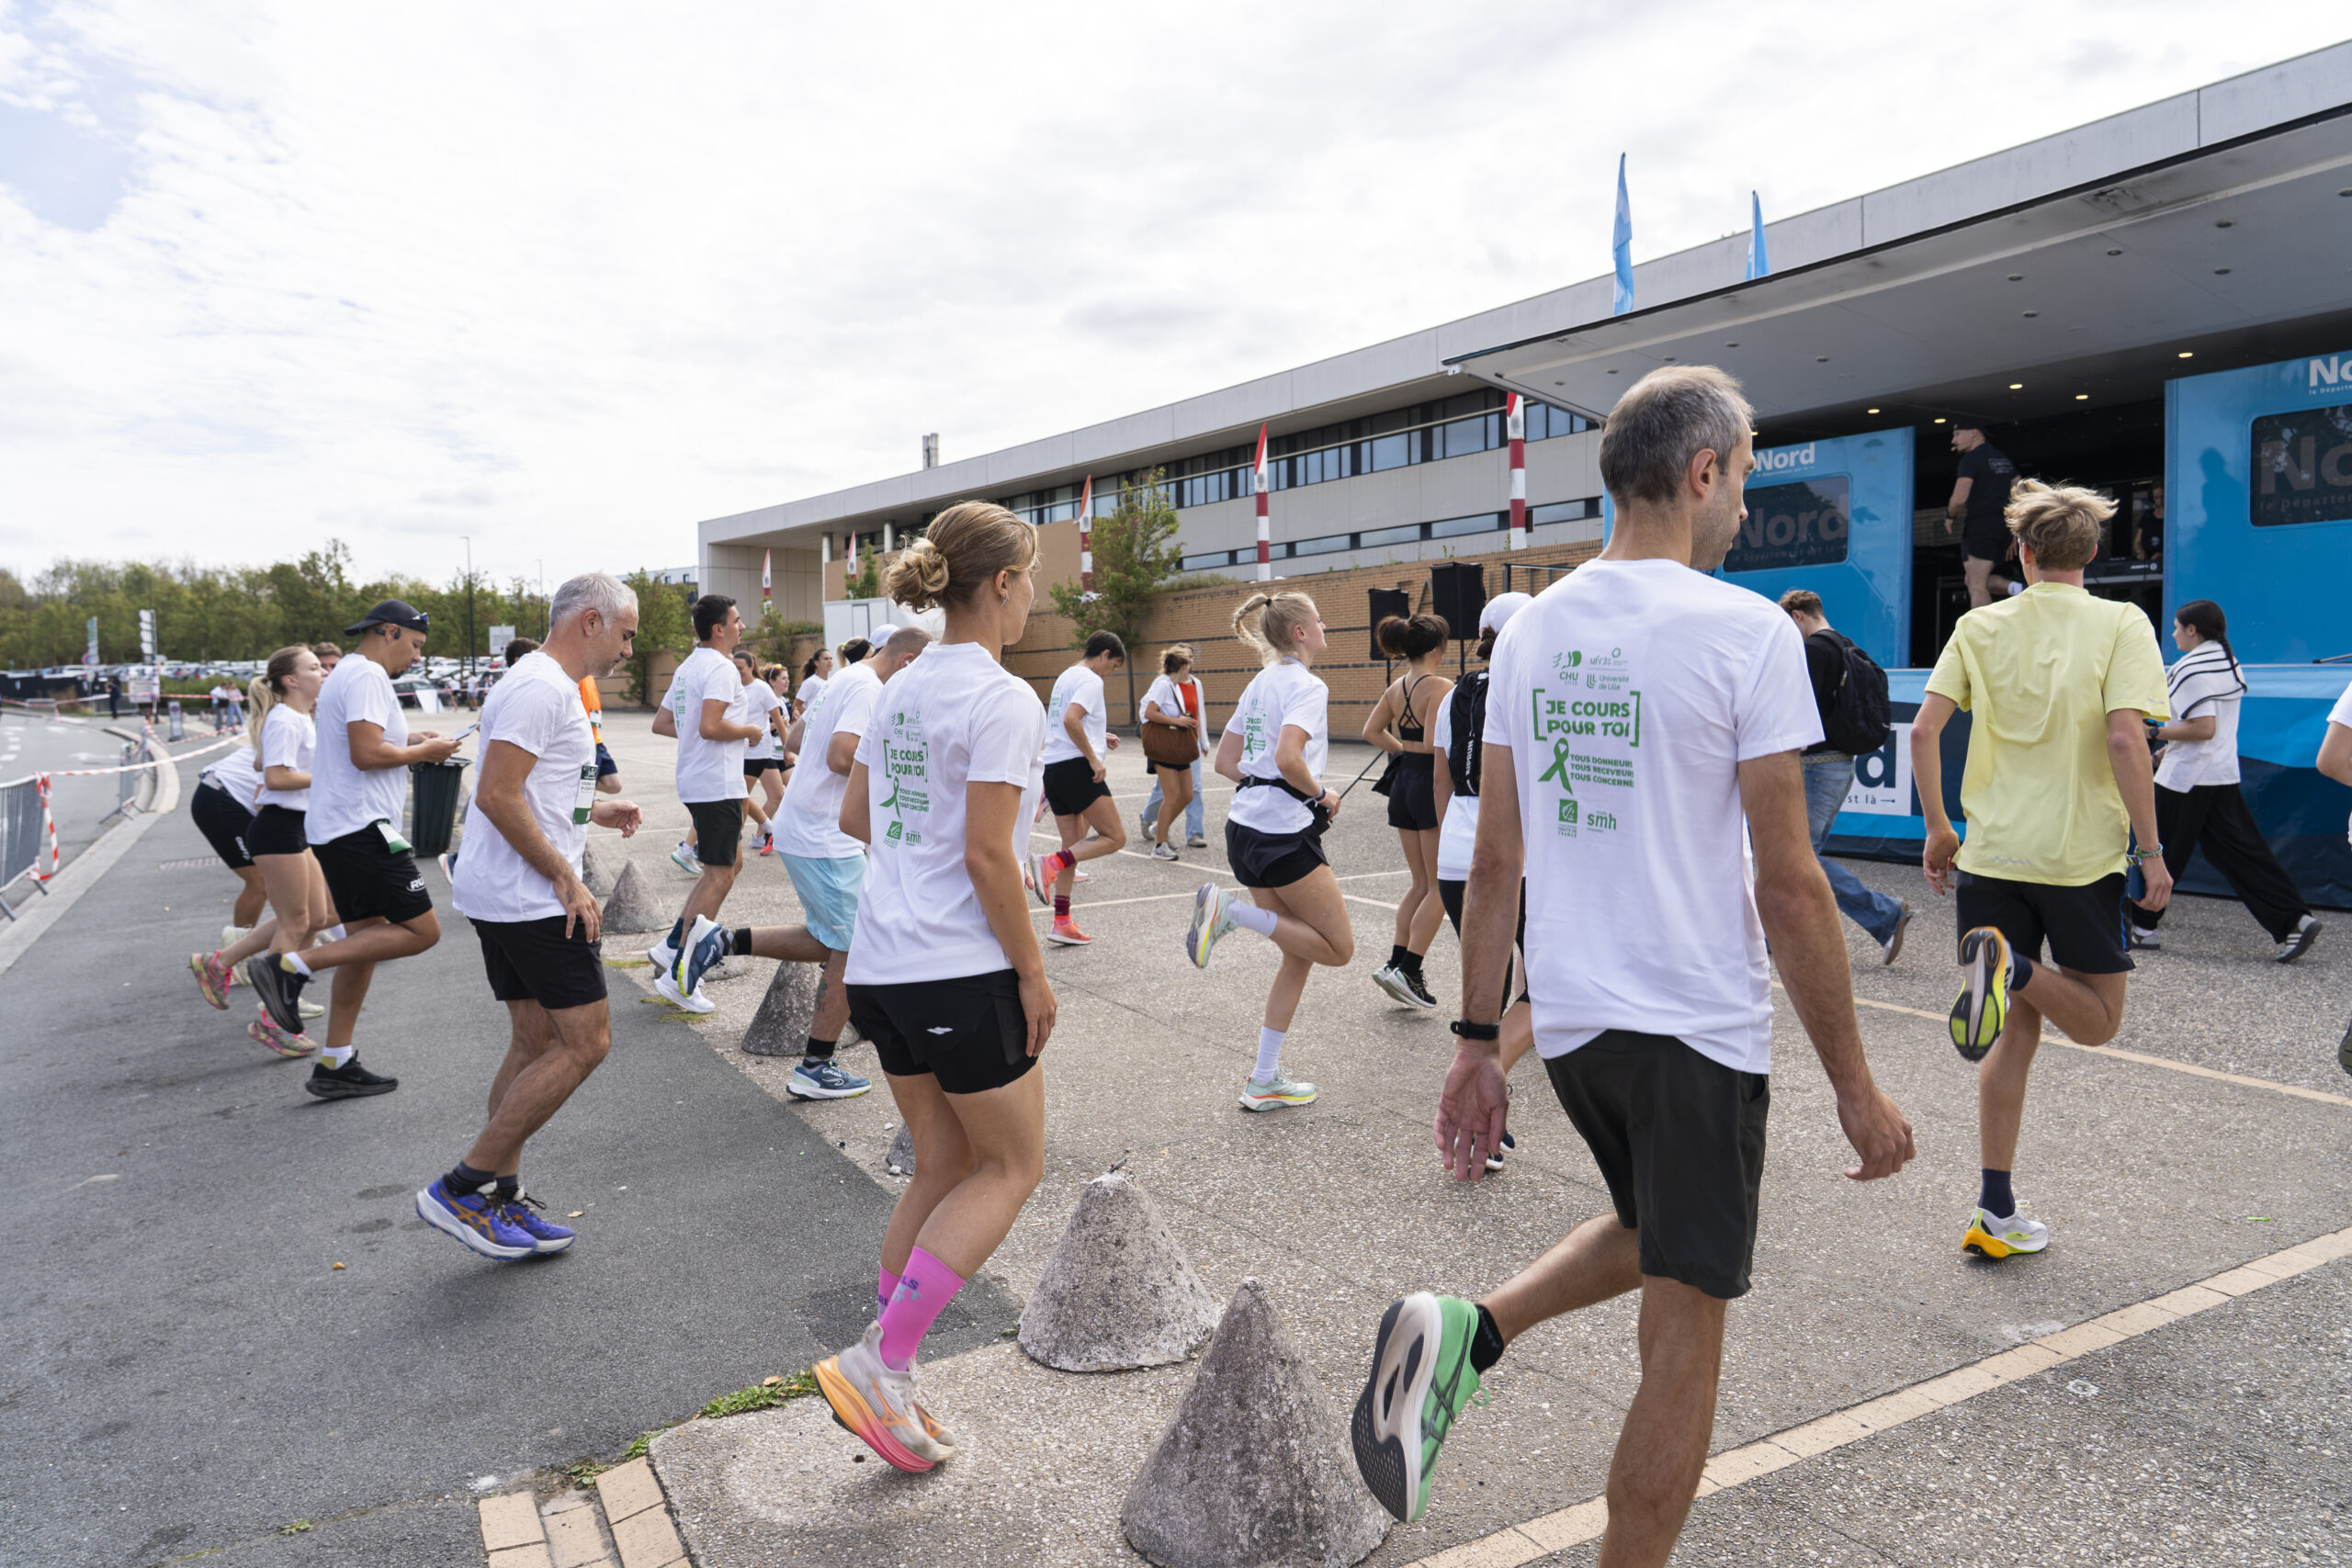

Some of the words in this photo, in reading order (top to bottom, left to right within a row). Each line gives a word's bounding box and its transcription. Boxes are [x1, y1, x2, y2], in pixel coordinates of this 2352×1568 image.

[1757, 442, 1815, 471] Nord
[1559, 671, 1578, 681] CHU
[1599, 674, 1630, 683] Université
[1608, 682, 1621, 691] Lille
[1545, 700, 1566, 715] JE
[1571, 701, 1630, 717] COURS
[1547, 719, 1596, 736] POUR
[1601, 721, 1630, 737] TOI
[1570, 754, 1590, 762] TOUS
[1570, 763, 1591, 772] TOUS
[1570, 773, 1591, 782] TOUS
[1846, 795, 1859, 804] st
[1587, 813, 1617, 830] smh
[410, 876, 424, 889] RU
